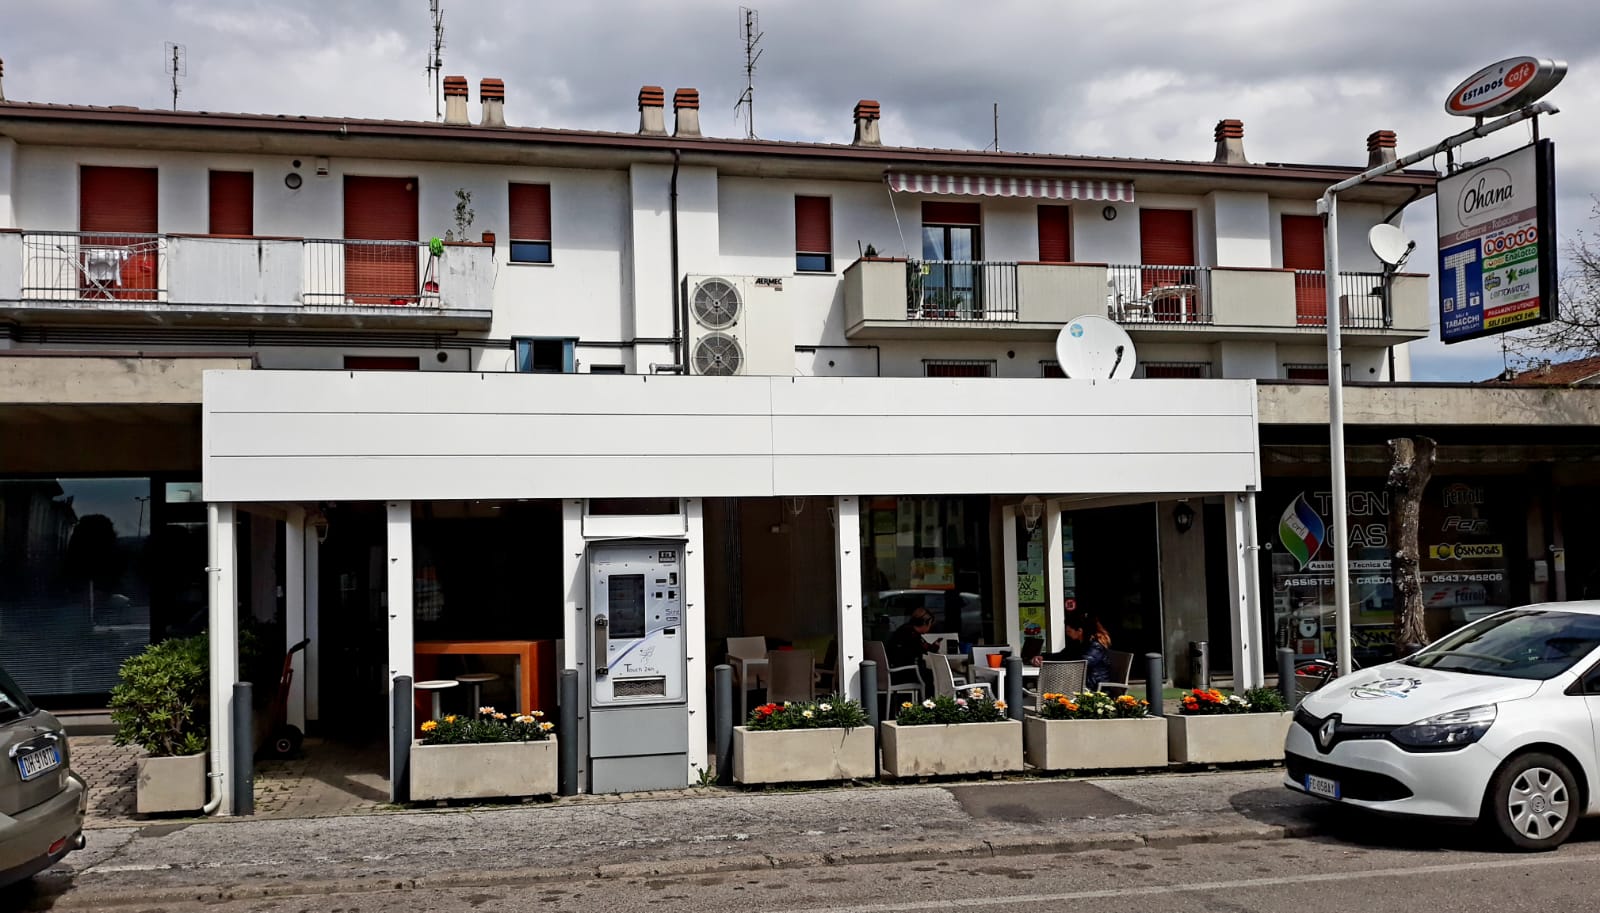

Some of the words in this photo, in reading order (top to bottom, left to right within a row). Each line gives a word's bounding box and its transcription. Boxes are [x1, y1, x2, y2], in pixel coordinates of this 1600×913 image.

[1463, 78, 1503, 102] ESTADOS
[1464, 177, 1512, 213] Ohana
[1486, 229, 1535, 254] LOTTO
[1518, 264, 1537, 277] Sisal
[1446, 315, 1480, 328] TABACCHI
[1501, 313, 1523, 325] SERVICE
[1314, 491, 1390, 515] TCN
[1454, 543, 1500, 560] COSMOGAS
[1353, 559, 1381, 568] Tecnica
[1284, 576, 1353, 587] ASSISTENA
[1357, 576, 1393, 585] CALDA
